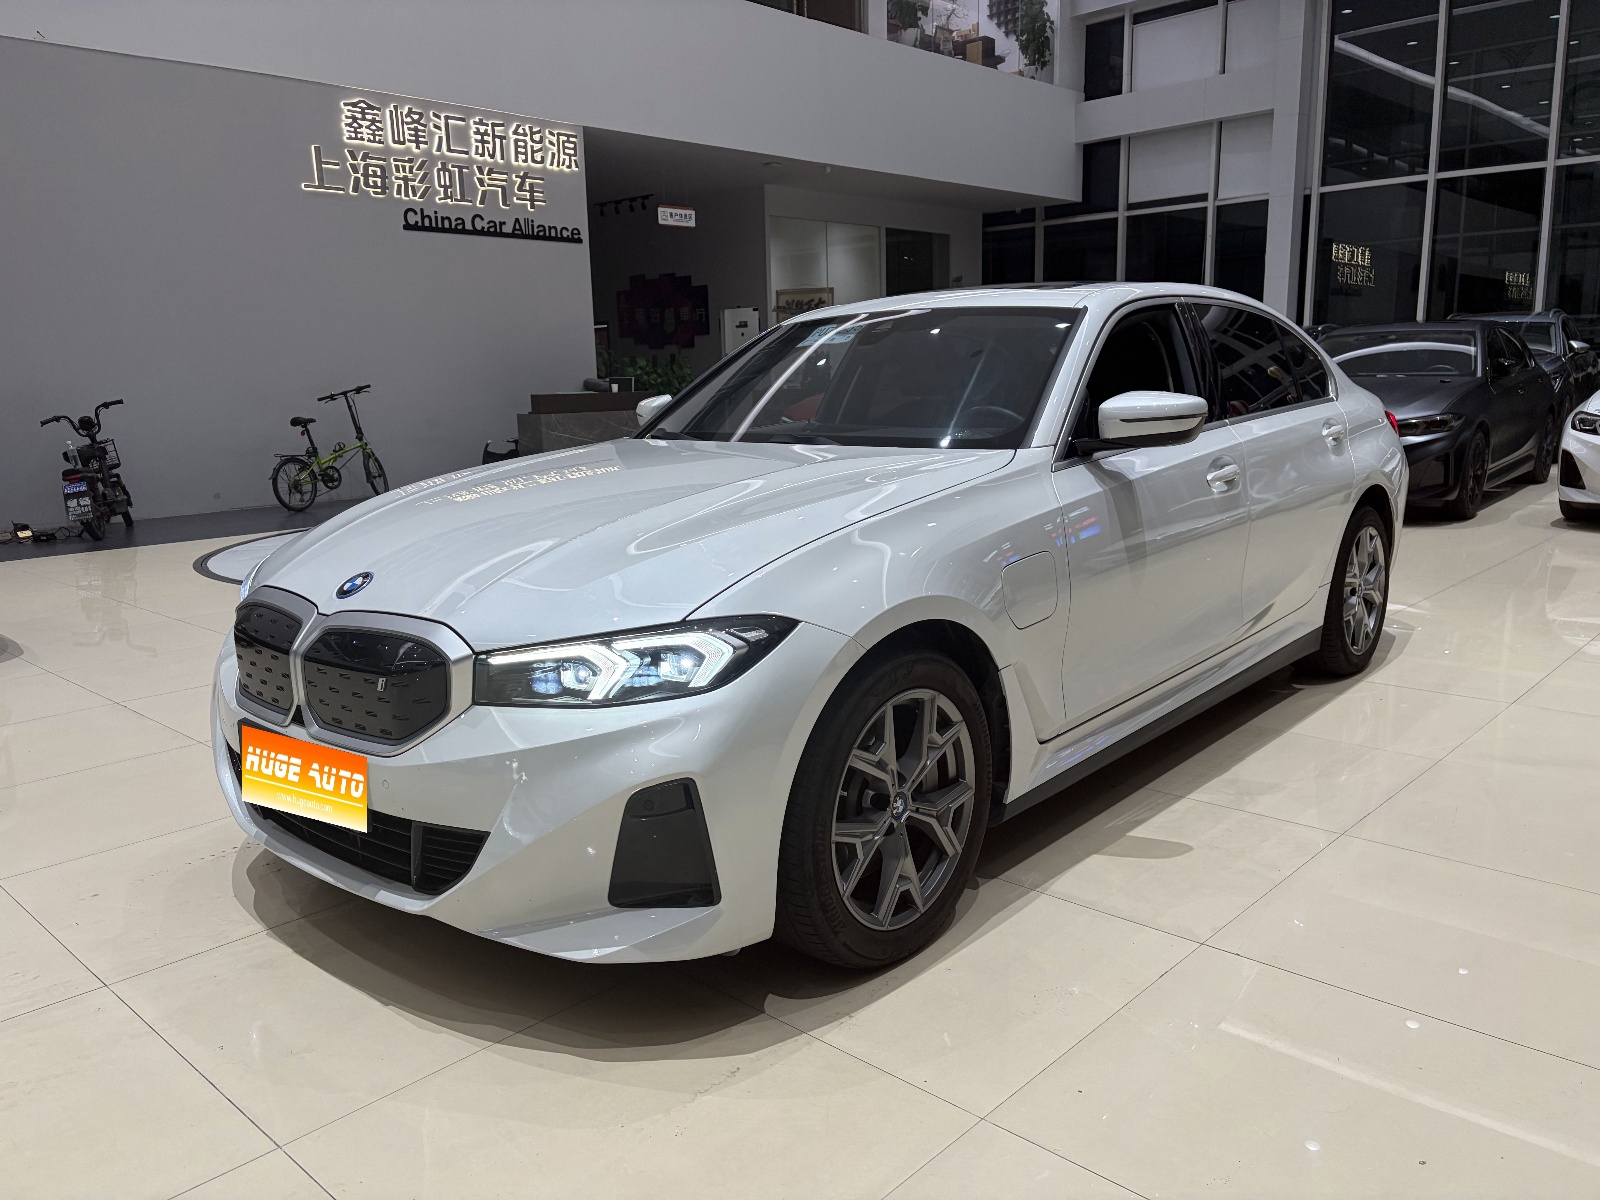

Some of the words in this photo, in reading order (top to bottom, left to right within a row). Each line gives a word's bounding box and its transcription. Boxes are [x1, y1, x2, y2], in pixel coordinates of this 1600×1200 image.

[341, 98, 580, 171] 鑫峰汇新能源
[301, 144, 547, 211] 上海彩虹汽车
[403, 207, 467, 230] China
[471, 213, 507, 233] Car
[511, 217, 582, 240] Alliance
